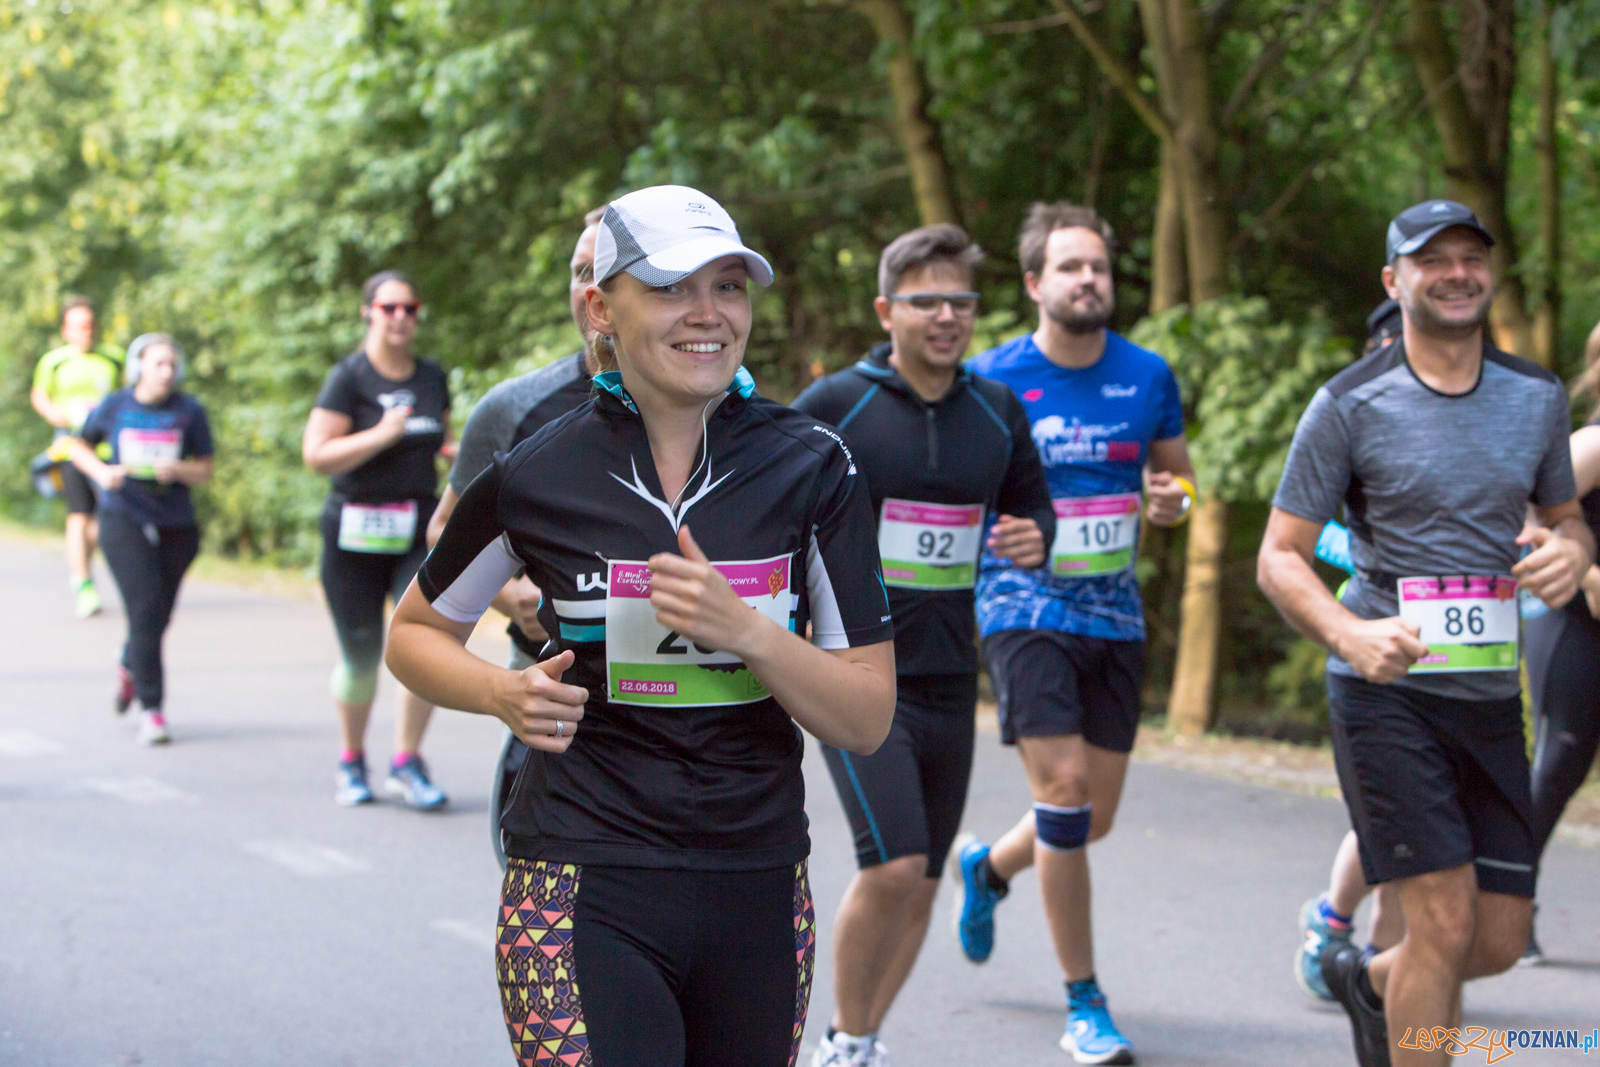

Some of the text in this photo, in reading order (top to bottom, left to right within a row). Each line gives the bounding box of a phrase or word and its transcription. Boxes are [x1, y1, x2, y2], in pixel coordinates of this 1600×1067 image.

[917, 531, 955, 558] 92
[1078, 521, 1122, 547] 107
[728, 577, 759, 585] DOWY.PL
[1445, 606, 1485, 636] 86
[621, 681, 675, 693] 22.06.2018
